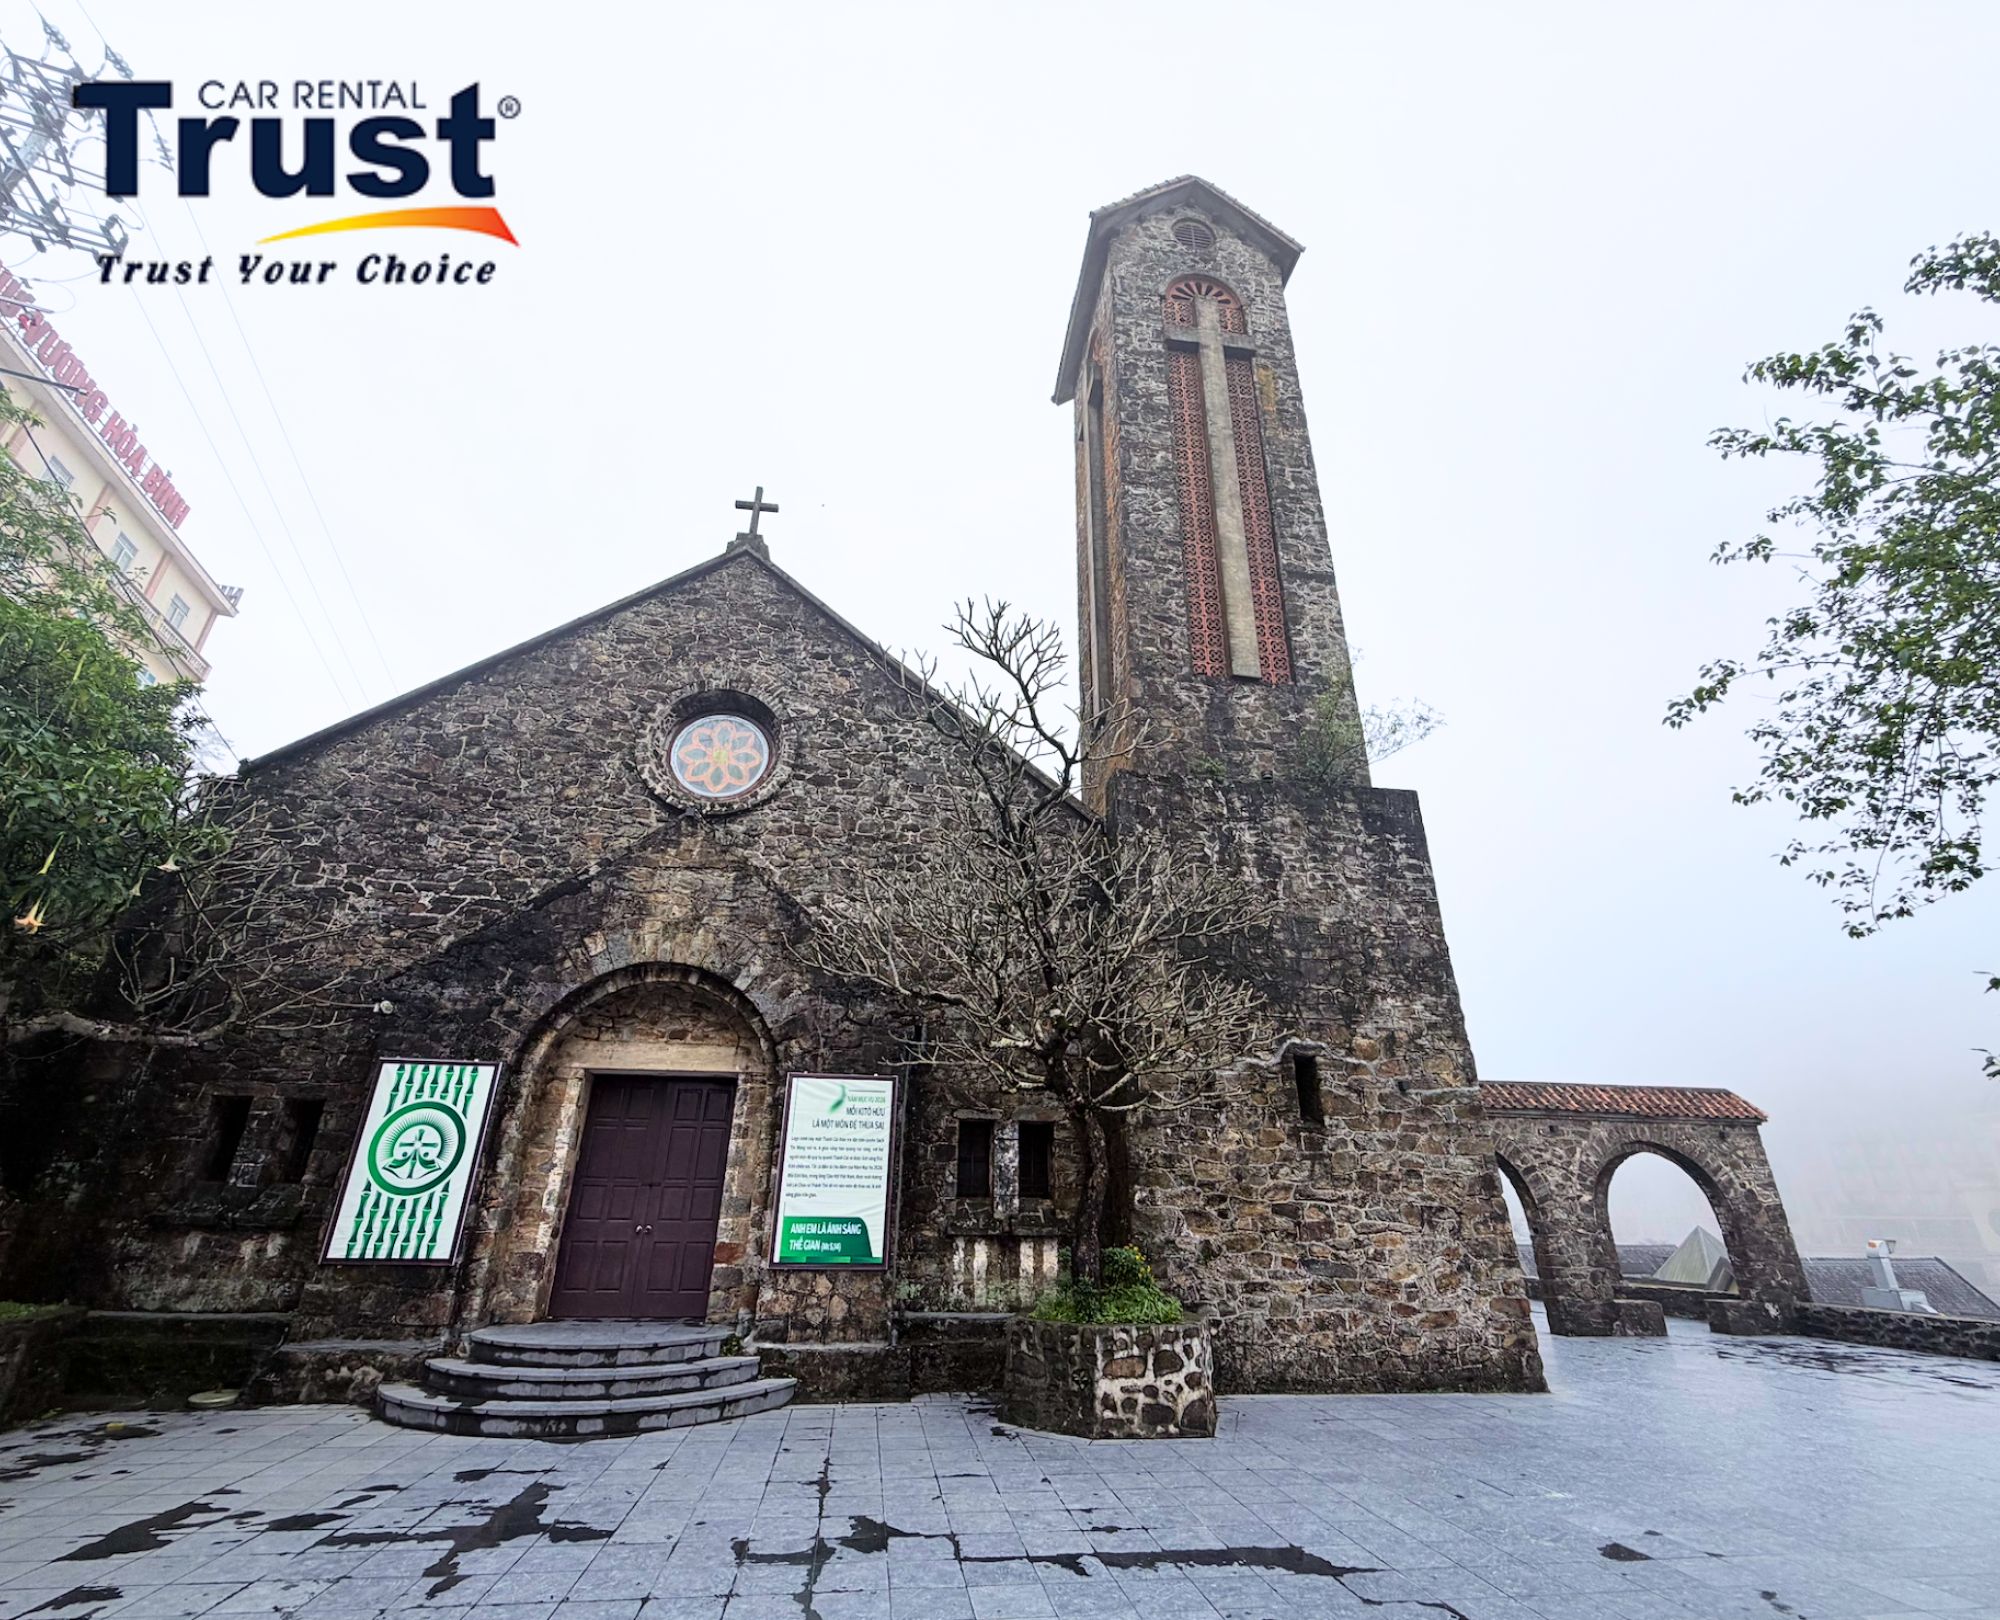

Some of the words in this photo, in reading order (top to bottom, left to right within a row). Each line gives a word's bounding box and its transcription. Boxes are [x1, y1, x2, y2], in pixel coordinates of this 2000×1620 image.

[101, 410, 148, 476] HÒA
[142, 463, 191, 529] BÌNH
[790, 1222, 806, 1234] ANH
[806, 1223, 817, 1234] EM
[817, 1221, 827, 1235] LÀ
[826, 1221, 842, 1235] ÁNH
[842, 1221, 862, 1235] SÁNG
[789, 1235, 804, 1251] THẾ
[803, 1239, 821, 1251] GIAN
